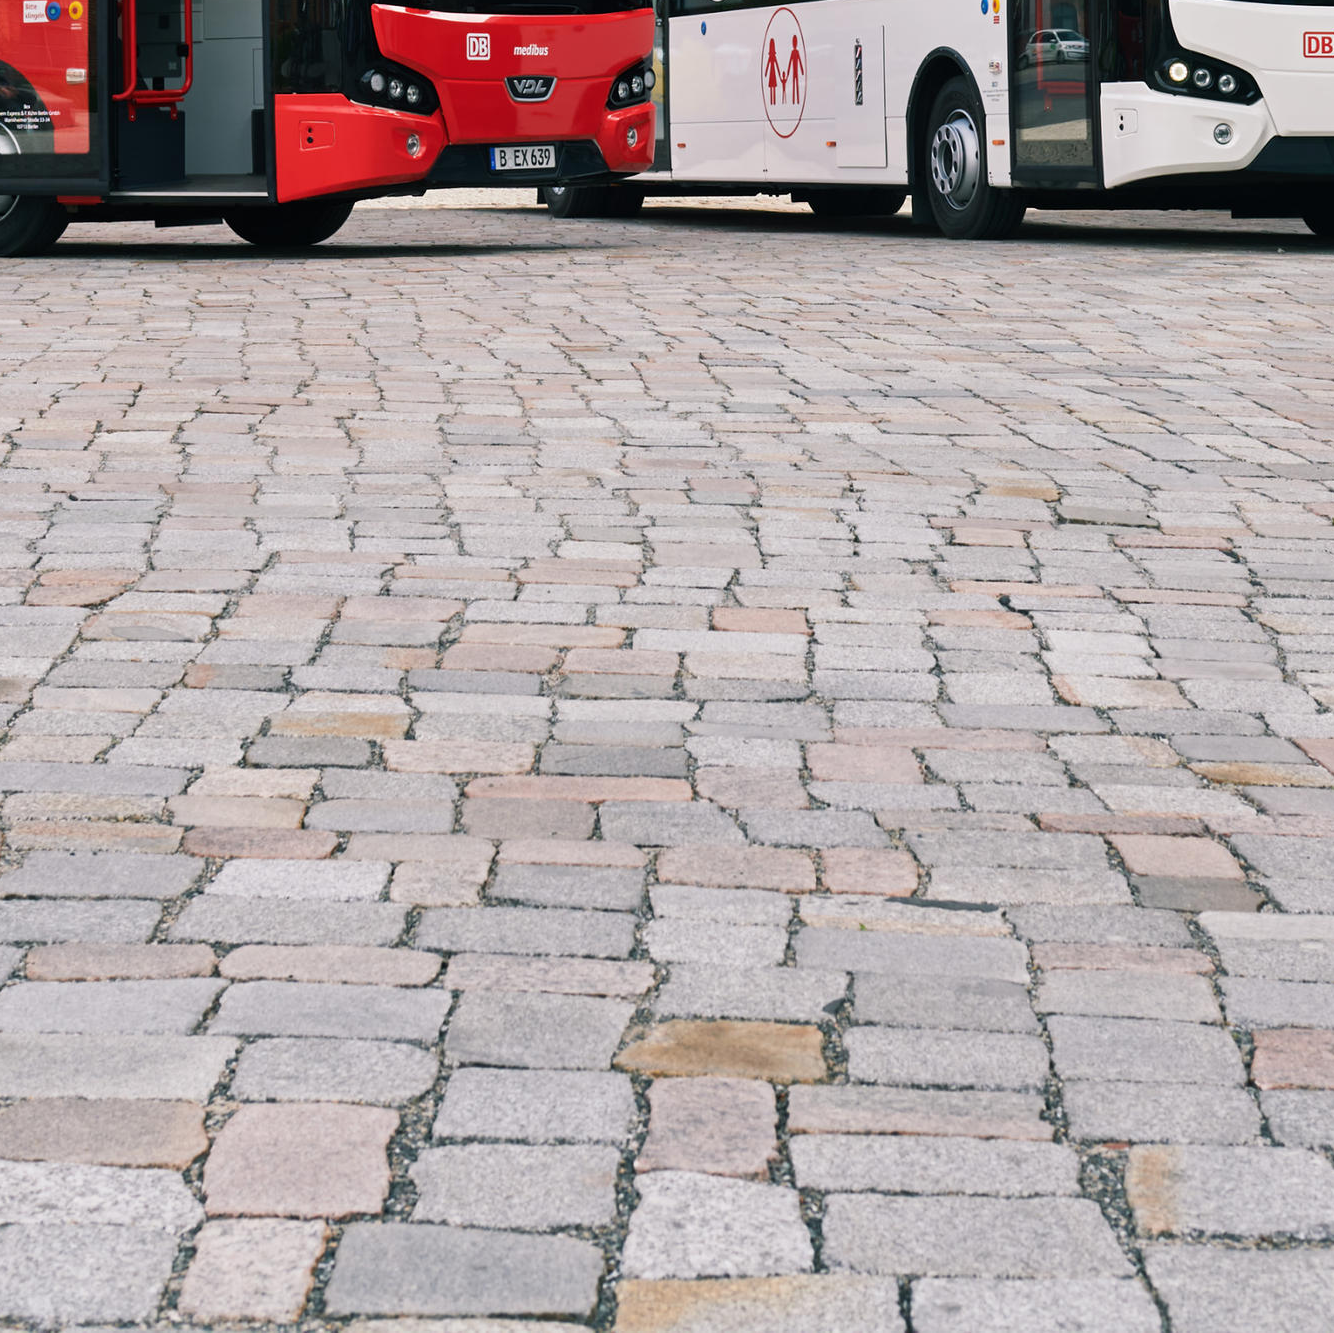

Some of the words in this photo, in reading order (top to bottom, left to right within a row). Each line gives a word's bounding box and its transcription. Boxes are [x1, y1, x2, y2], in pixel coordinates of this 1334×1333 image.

[513, 44, 549, 56] medibus
[513, 79, 547, 94] VDL
[499, 149, 507, 167] B
[514, 149, 529, 167] EX
[530, 148, 551, 166] 639
